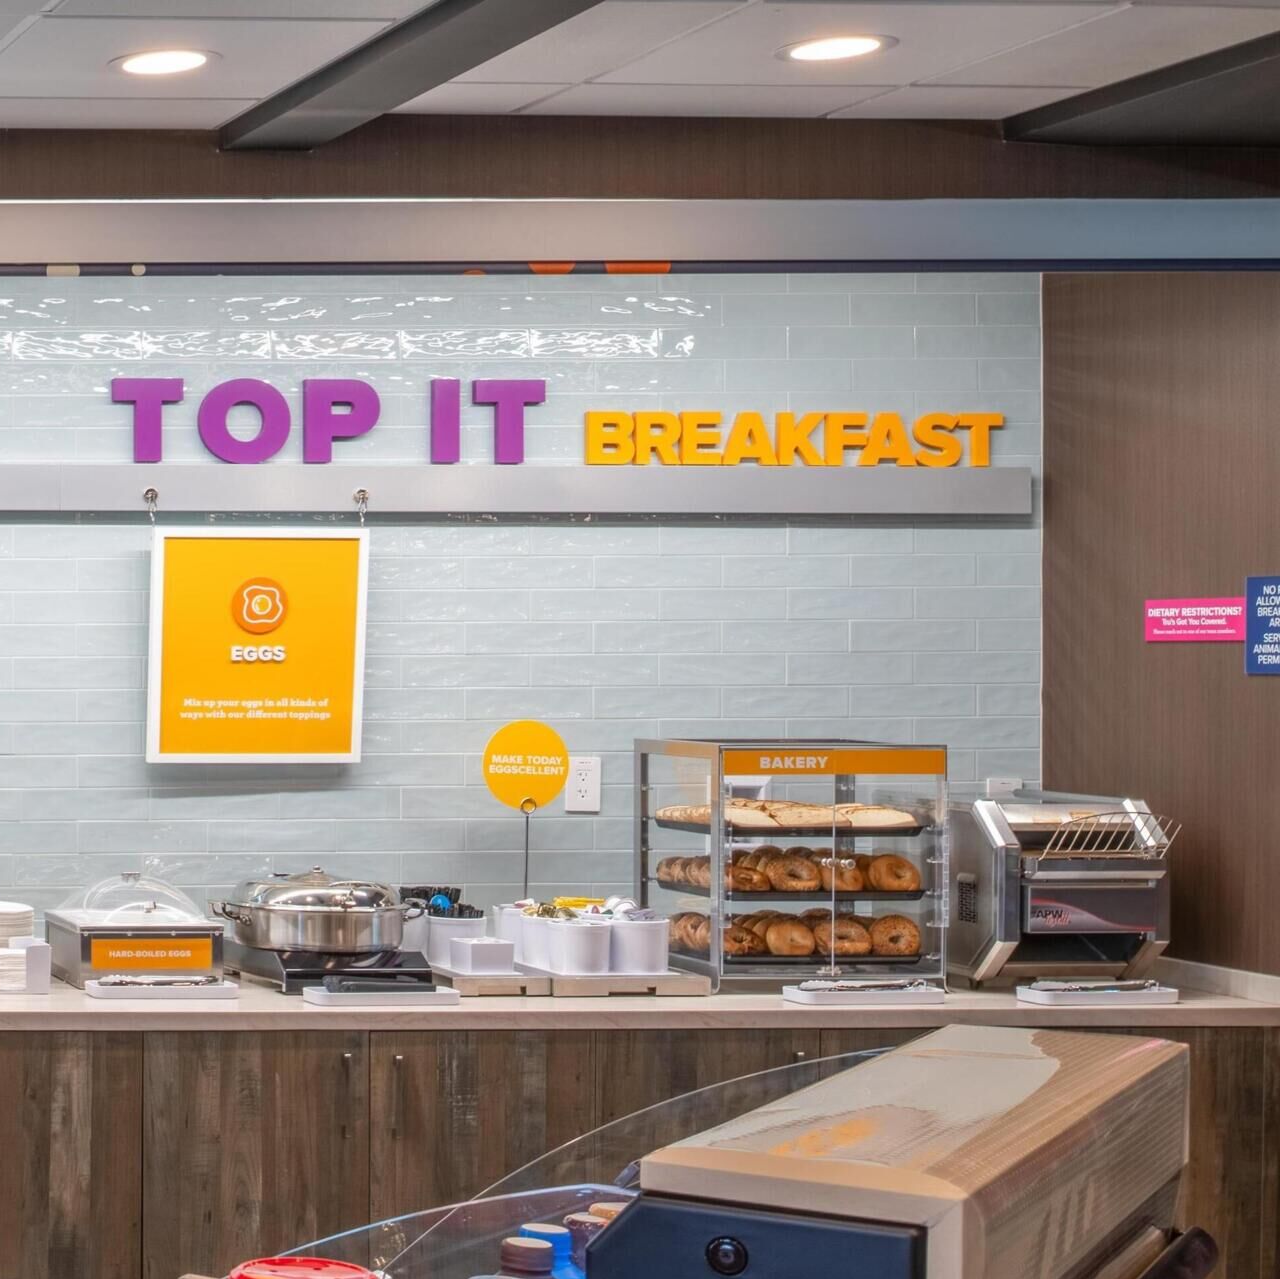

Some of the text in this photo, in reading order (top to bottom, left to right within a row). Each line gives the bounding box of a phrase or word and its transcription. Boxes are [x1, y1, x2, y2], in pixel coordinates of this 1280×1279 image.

[110, 378, 547, 465] TOP IT
[584, 410, 1005, 468] BREAKFAST
[1263, 585, 1276, 595] NO
[1148, 606, 1242, 617] DIETARY RESTRICTIONS?
[230, 646, 286, 662] EGGS
[183, 698, 329, 709] Mix up your eggs in all kinds of
[180, 711, 203, 720] ways
[205, 710, 226, 718] with
[246, 710, 288, 718] different
[289, 710, 331, 720] toppings
[491, 754, 562, 765] MAKE TODAY
[759, 756, 829, 770] BAKERY
[488, 764, 565, 775] EGGSCELLENT
[1036, 909, 1064, 918] APW
[108, 950, 192, 958] HARD-BOILED EGGS
